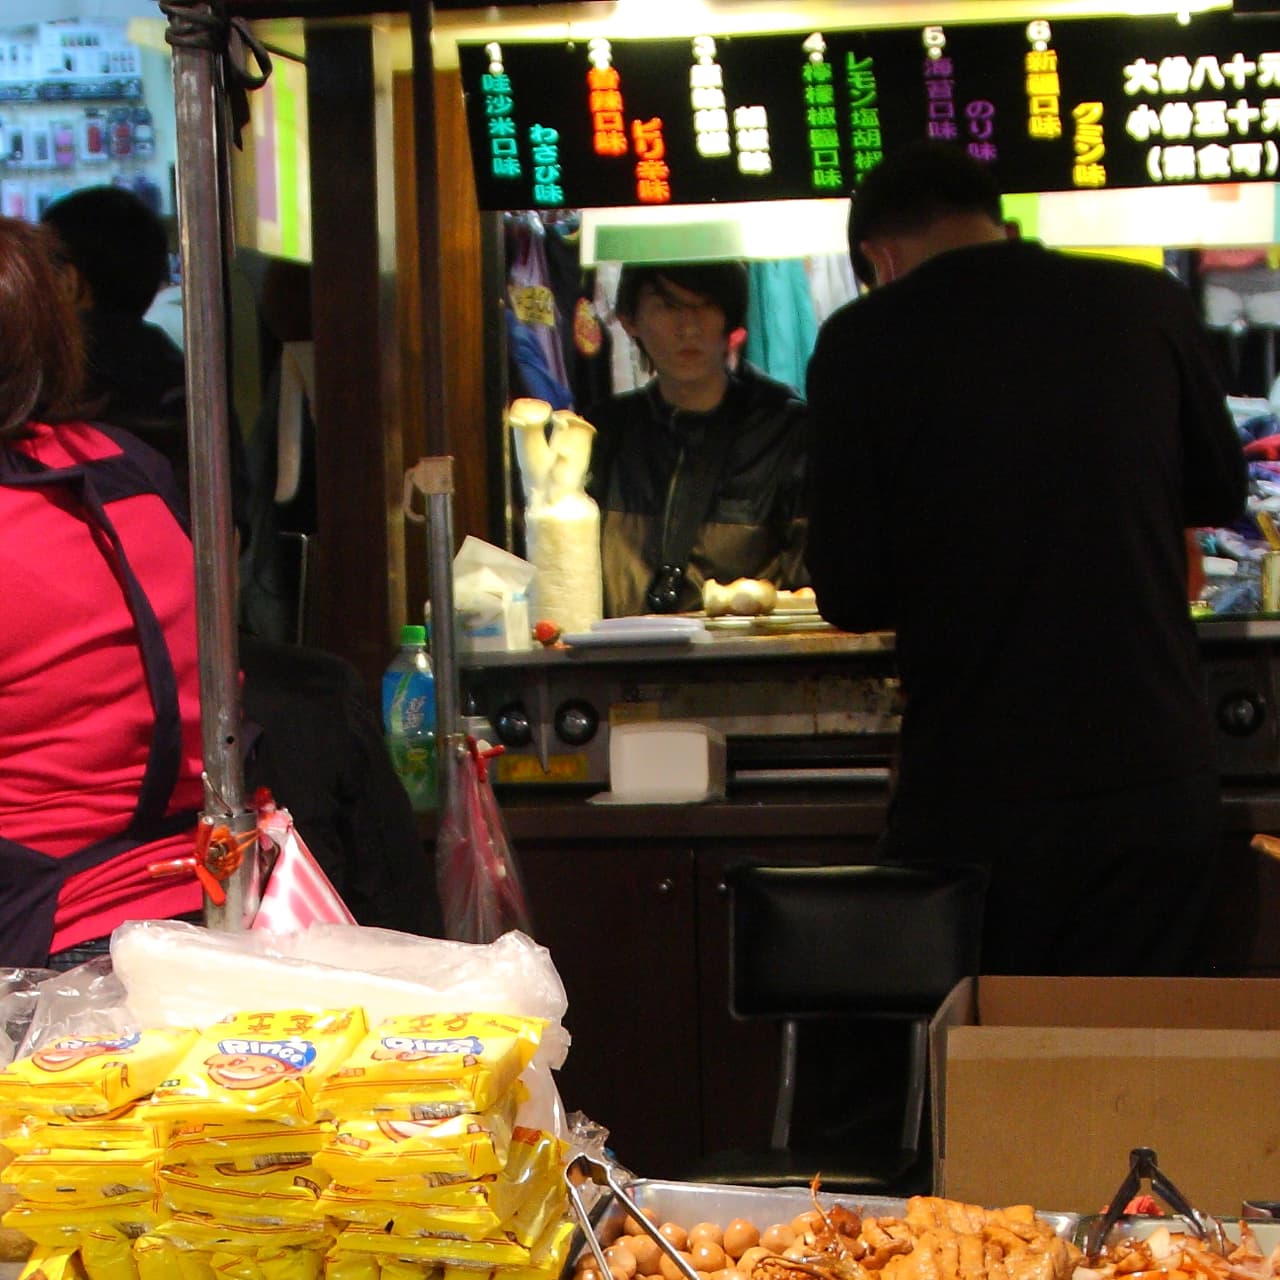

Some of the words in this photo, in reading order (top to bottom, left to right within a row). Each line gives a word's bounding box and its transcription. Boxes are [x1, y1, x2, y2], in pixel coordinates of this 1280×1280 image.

[845, 50, 883, 184] レモン塩胡椒
[966, 100, 997, 161] のり味
[1072, 101, 1106, 187] クミン味
[528, 123, 564, 204] わさび味
